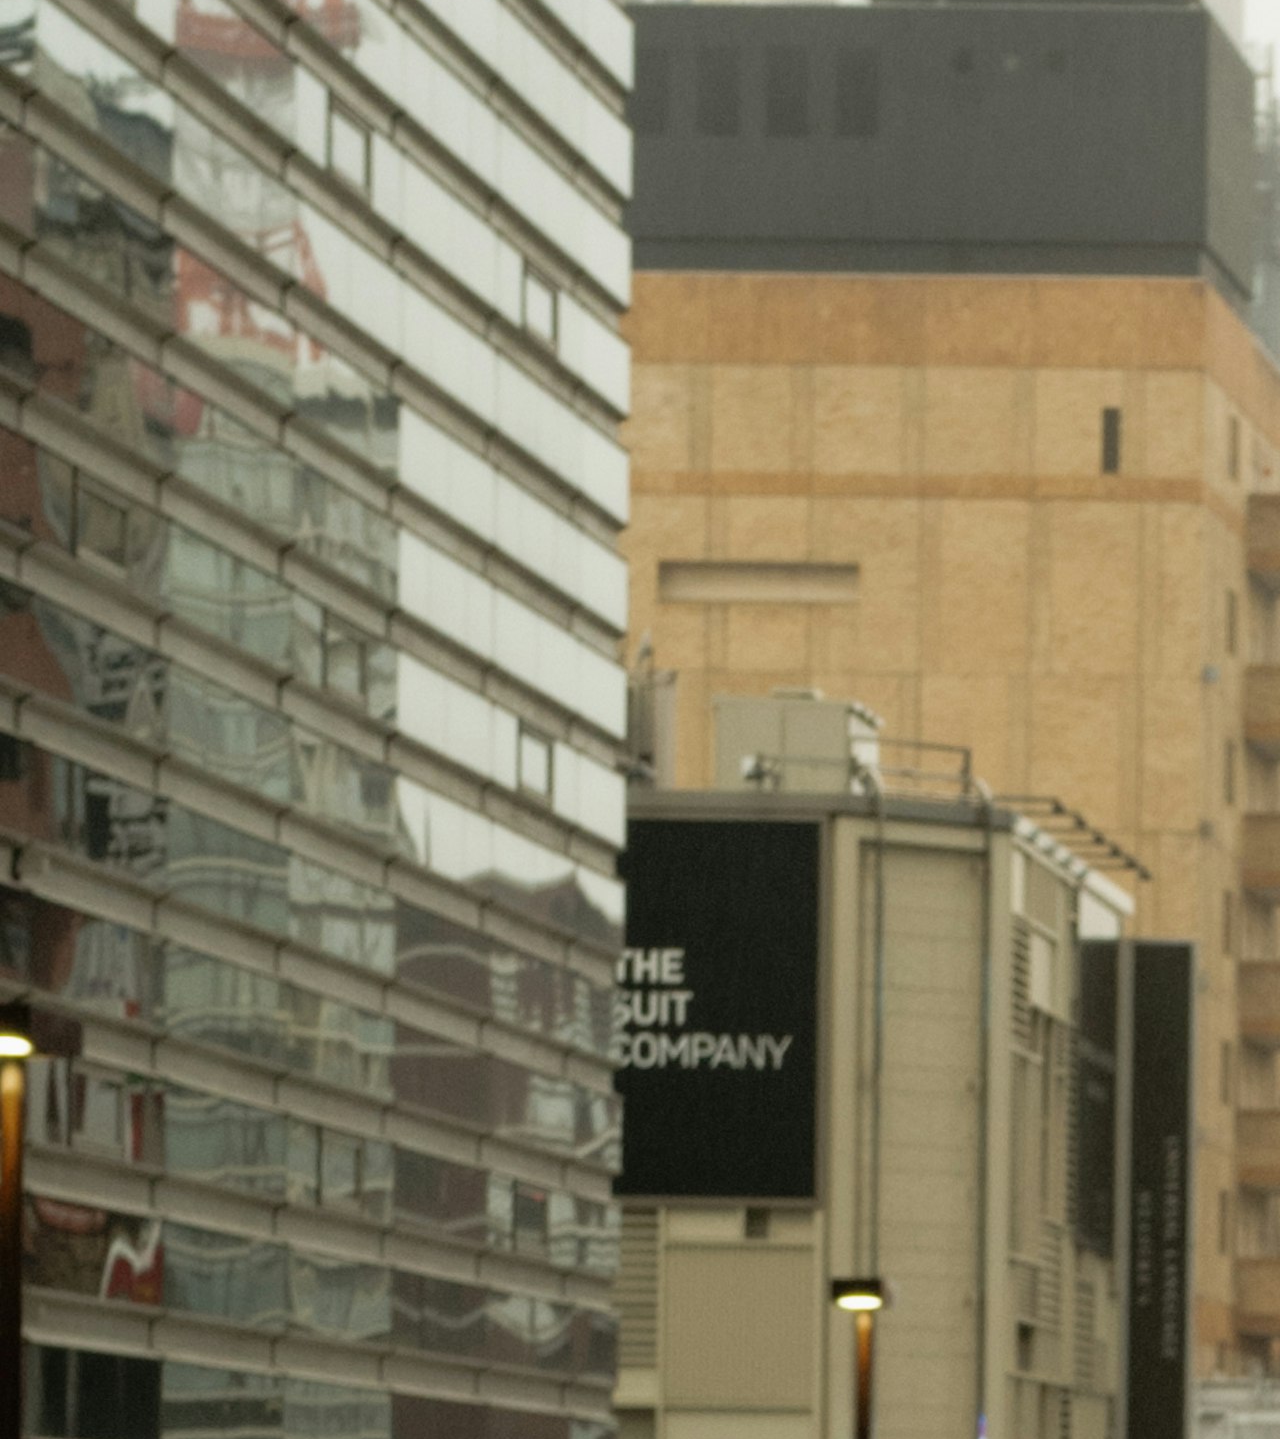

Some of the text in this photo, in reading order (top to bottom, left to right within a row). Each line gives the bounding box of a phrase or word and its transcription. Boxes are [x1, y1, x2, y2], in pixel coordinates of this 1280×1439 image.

[615, 948, 686, 985] THE
[611, 990, 695, 1028] SUIT
[607, 1031, 795, 1071] COMPANY
